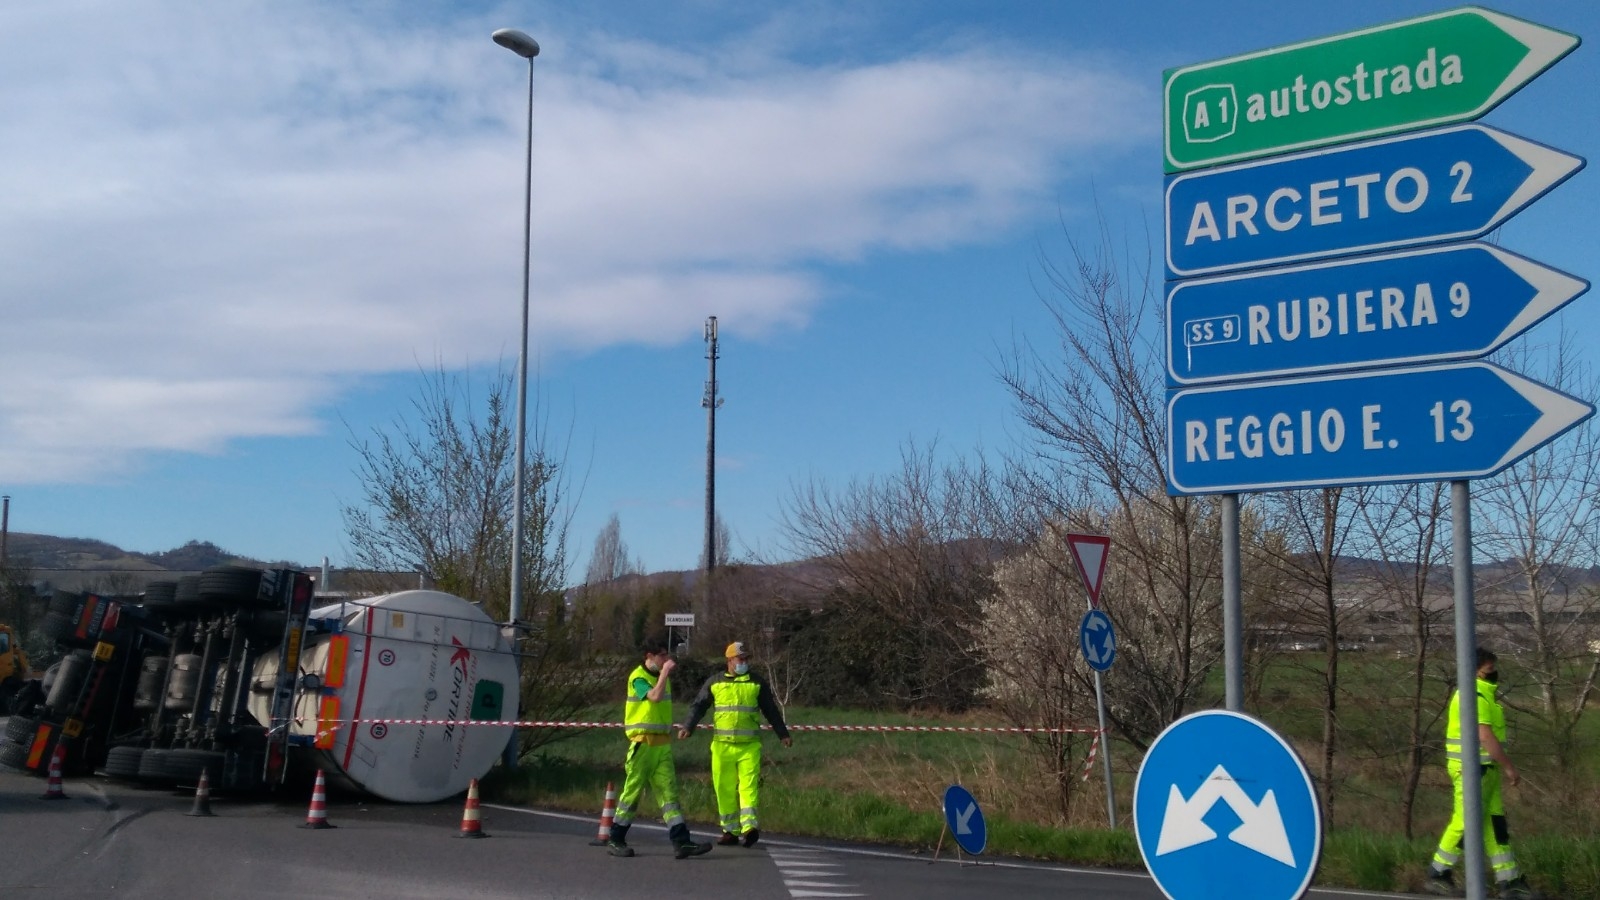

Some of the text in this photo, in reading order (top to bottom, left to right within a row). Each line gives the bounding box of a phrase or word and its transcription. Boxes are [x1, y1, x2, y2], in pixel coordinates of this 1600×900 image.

[1194, 47, 1464, 129] A 1 autostrada
[1185, 161, 1473, 246] ARCETO 2
[1191, 281, 1471, 345] SS 9 RUBIERA 9
[1185, 399, 1474, 463] REGGIO E. 13
[383, 654, 391, 663] 70
